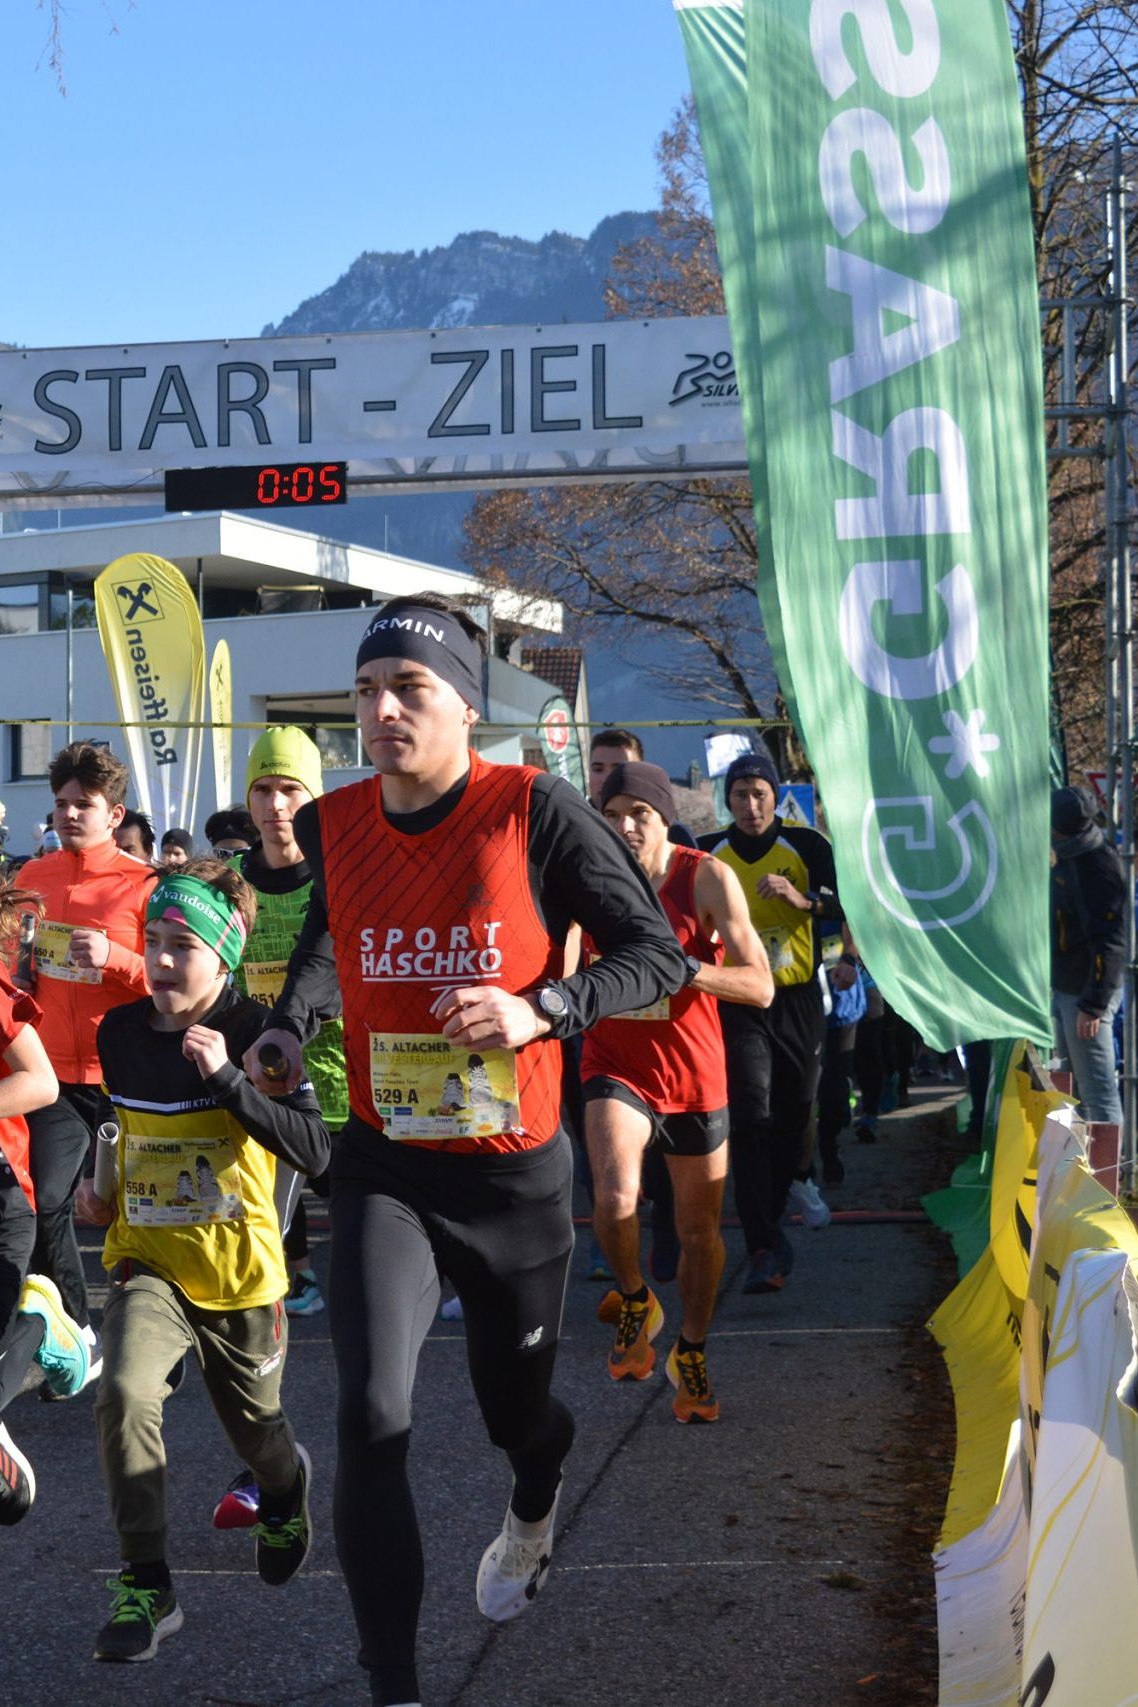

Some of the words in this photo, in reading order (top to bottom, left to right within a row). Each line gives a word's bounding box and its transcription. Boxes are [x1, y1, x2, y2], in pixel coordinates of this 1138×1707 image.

[34, 356, 337, 456] START
[428, 343, 644, 439] ZIEL
[258, 465, 341, 504] 0:05
[164, 889, 222, 925] vaudoise
[360, 921, 502, 952] SPORT
[360, 947, 503, 976] HASCHKO
[373, 1041, 389, 1052] 25.
[392, 1042, 450, 1053] ALTACHER
[374, 1088, 402, 1105] 529
[407, 1088, 419, 1105] A
[138, 1143, 182, 1154] ALTACHER
[126, 1181, 146, 1196] 558
[148, 1183, 158, 1197] A
